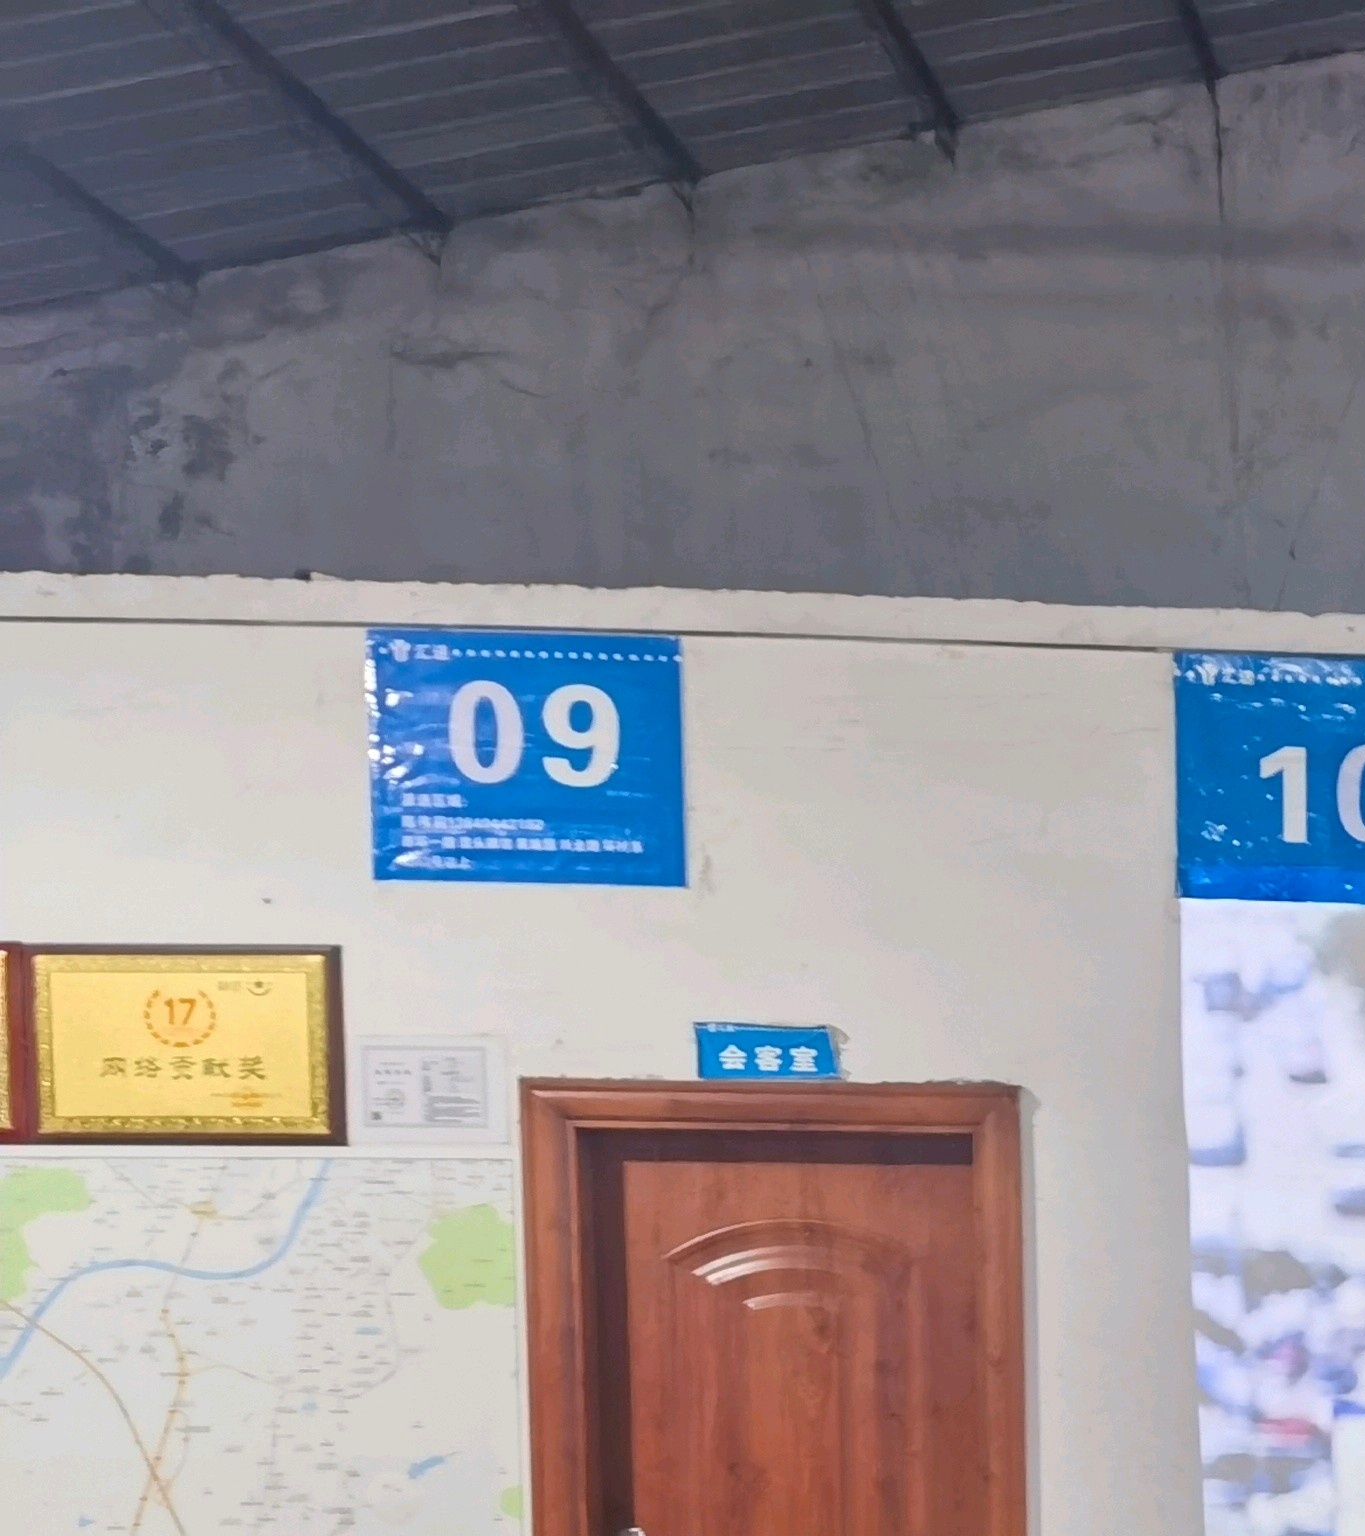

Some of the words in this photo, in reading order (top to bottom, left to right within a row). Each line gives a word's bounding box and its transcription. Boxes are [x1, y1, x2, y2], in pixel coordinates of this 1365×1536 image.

[449, 680, 620, 788] 09
[163, 998, 197, 1026] 17
[718, 1044, 818, 1072] 会客室
